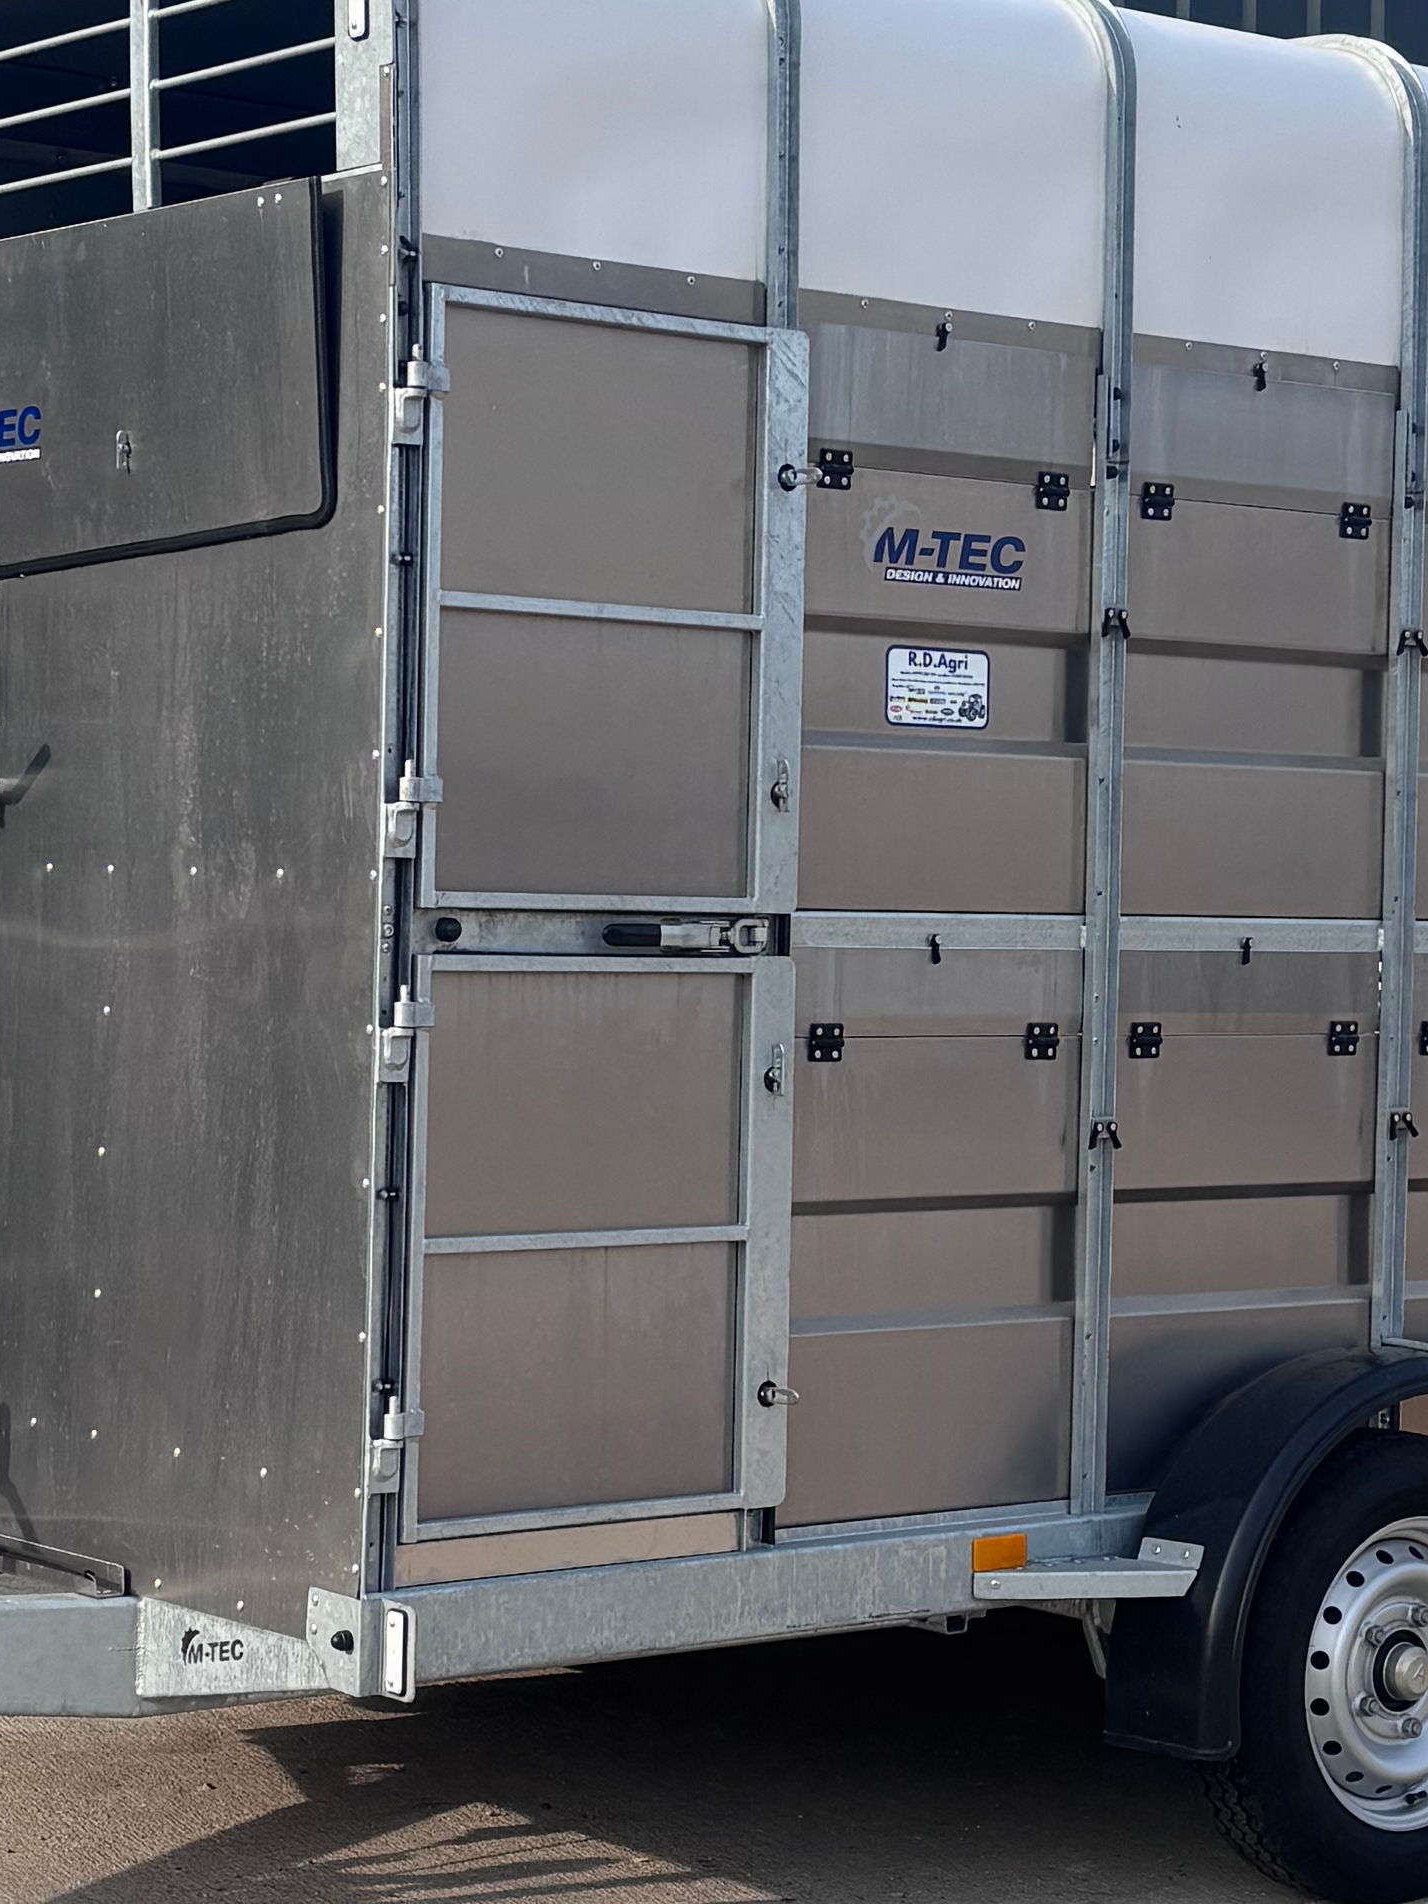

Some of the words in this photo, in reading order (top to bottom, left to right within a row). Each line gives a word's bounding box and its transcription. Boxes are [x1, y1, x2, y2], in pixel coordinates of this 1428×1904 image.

[873, 526, 1026, 575] M-TEC
[886, 568, 933, 583] DESIGN
[947, 574, 1021, 590] INNOVATION
[908, 651, 969, 673] R.D.Agri
